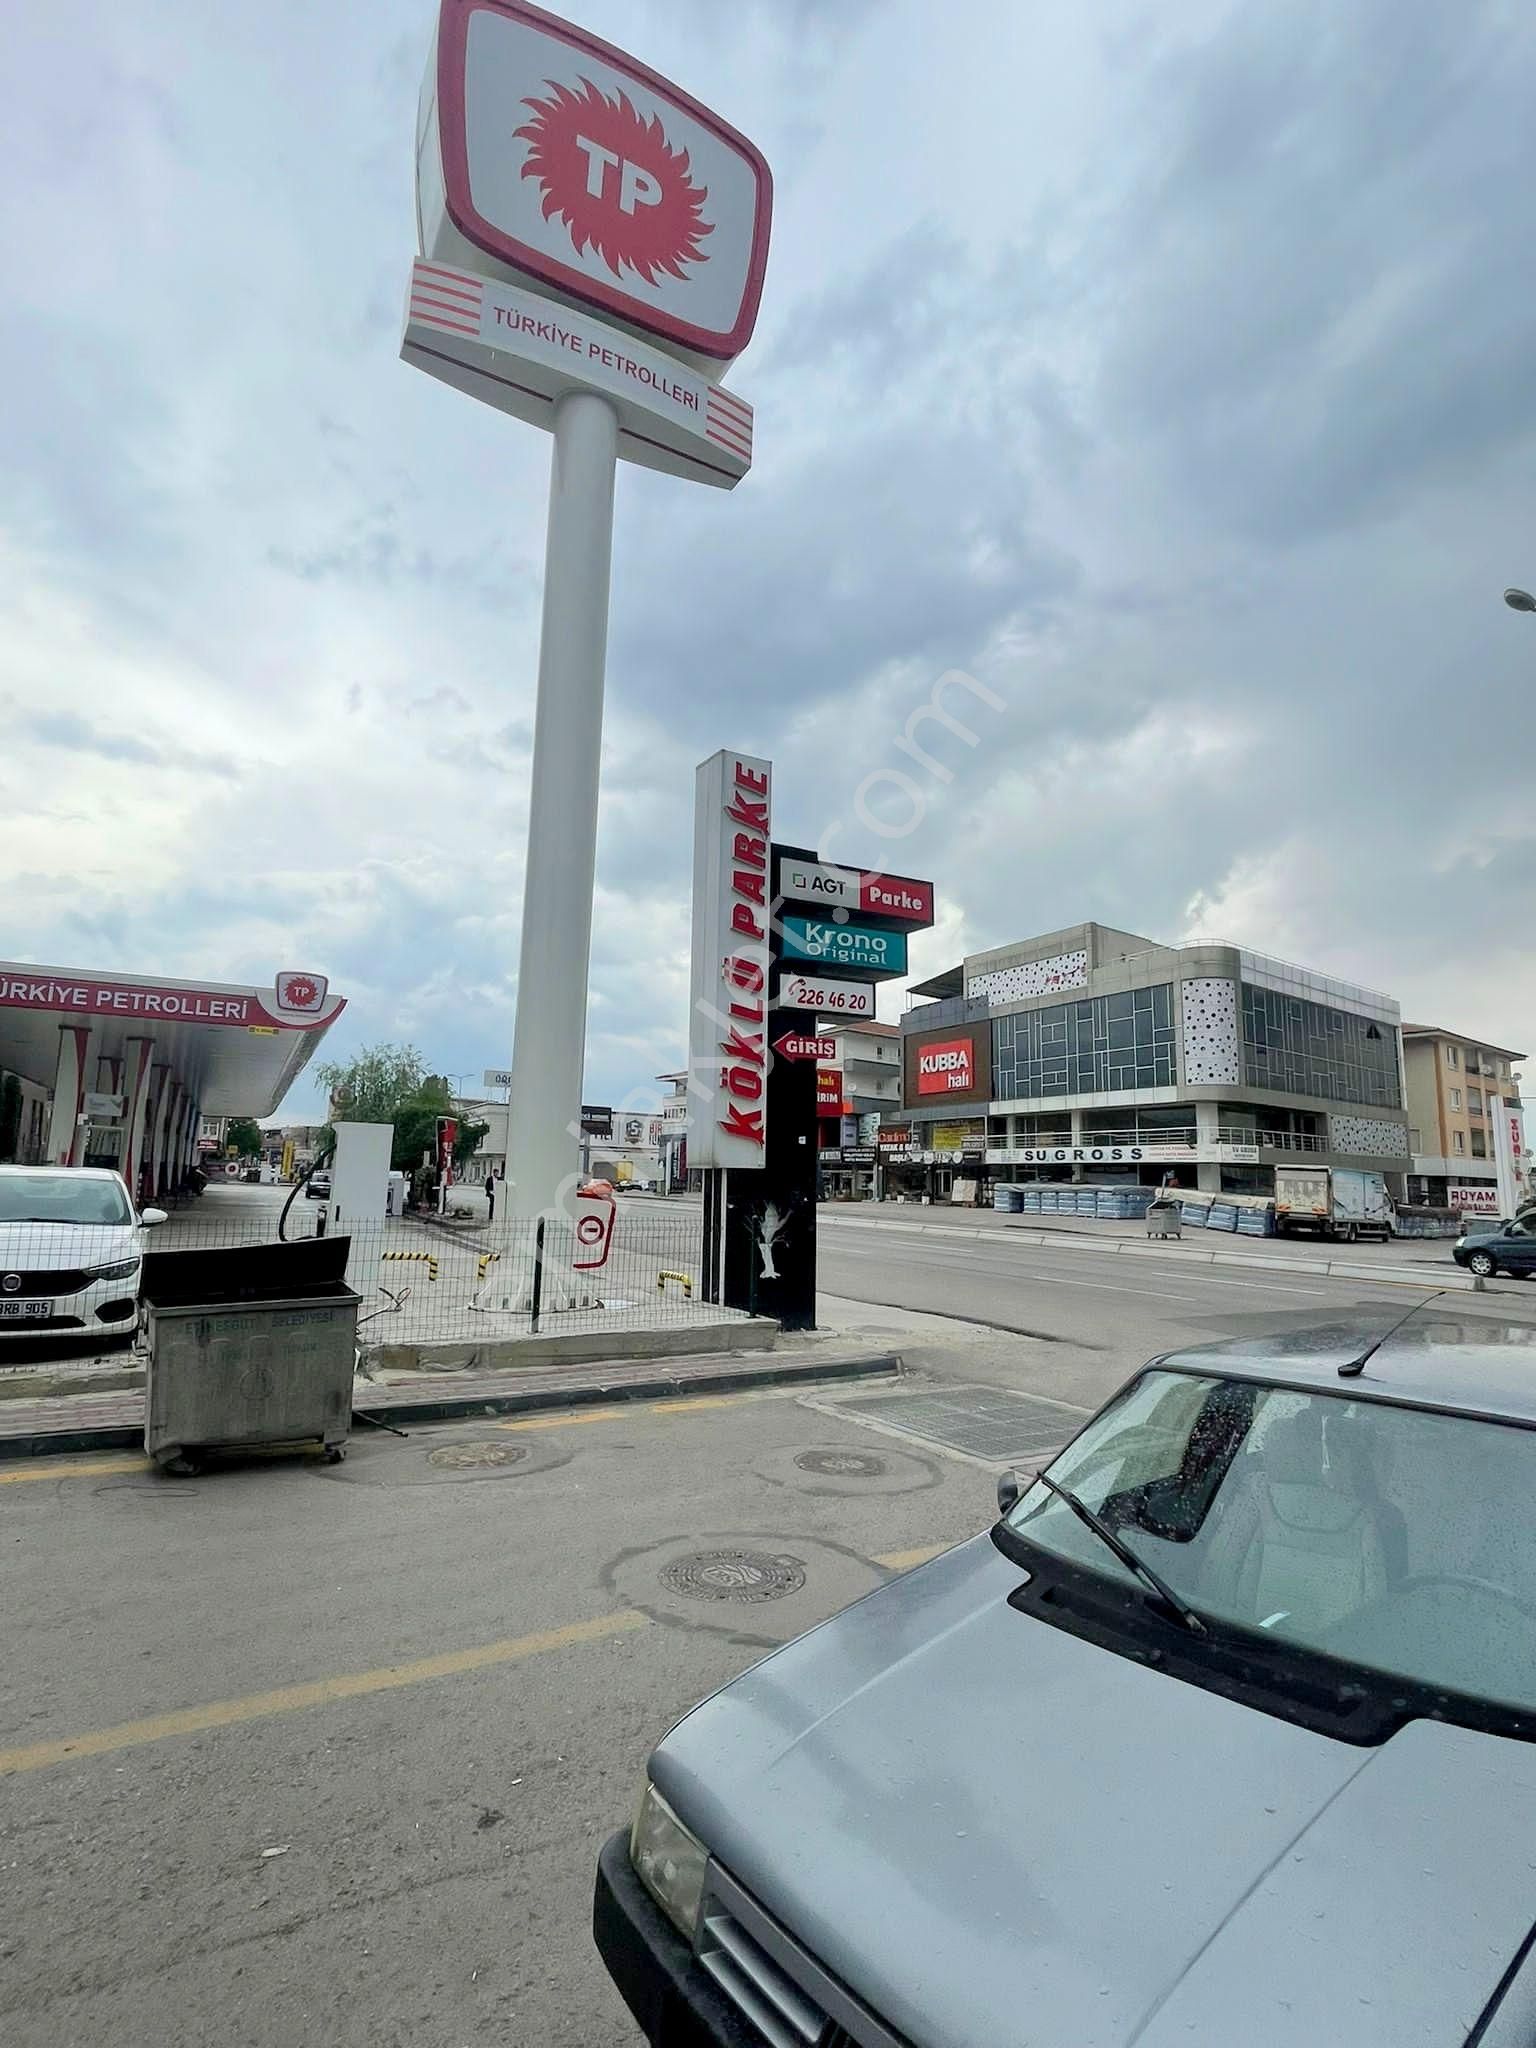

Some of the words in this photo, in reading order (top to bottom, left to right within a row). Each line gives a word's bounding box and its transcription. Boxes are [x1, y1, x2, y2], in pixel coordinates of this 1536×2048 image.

[576, 134, 663, 216] TP
[493, 305, 582, 355] TÜRKİYE
[587, 343, 700, 412] PETROLLERİ
[724, 760, 770, 940] PARKE
[811, 876, 846, 897] AGT
[869, 885, 923, 911] Parke
[805, 922, 888, 952] Krono
[805, 941, 887, 966] Original
[294, 986, 310, 997] TP
[797, 988, 825, 1007] 226
[828, 990, 848, 1008] 46
[848, 992, 867, 1010] 20
[96, 990, 248, 1020] PETROLLERİ
[719, 955, 767, 1149] KÖKLÜ
[785, 1037, 835, 1059] GİRİŞ
[919, 1050, 969, 1074] KUBBA
[947, 1072, 969, 1089] halı
[25, 1302, 48, 1314] 905
